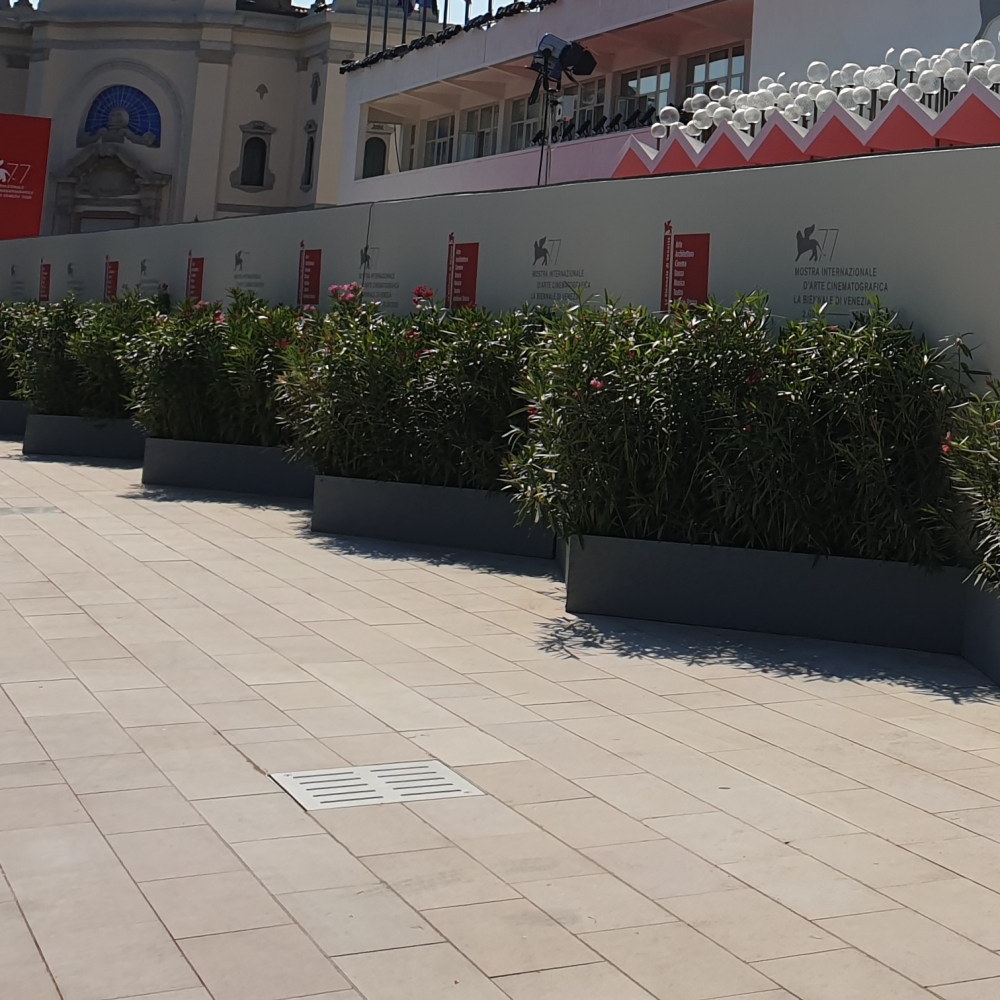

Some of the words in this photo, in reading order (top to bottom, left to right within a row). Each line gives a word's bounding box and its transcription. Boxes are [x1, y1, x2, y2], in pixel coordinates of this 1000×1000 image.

[818, 228, 839, 262] 77
[794, 267, 820, 277] MOSTRA
[822, 267, 877, 277] INTERNAZIONALE
[803, 281, 825, 291] D'ARTE
[826, 281, 888, 292] CINEMATOGRAFICA
